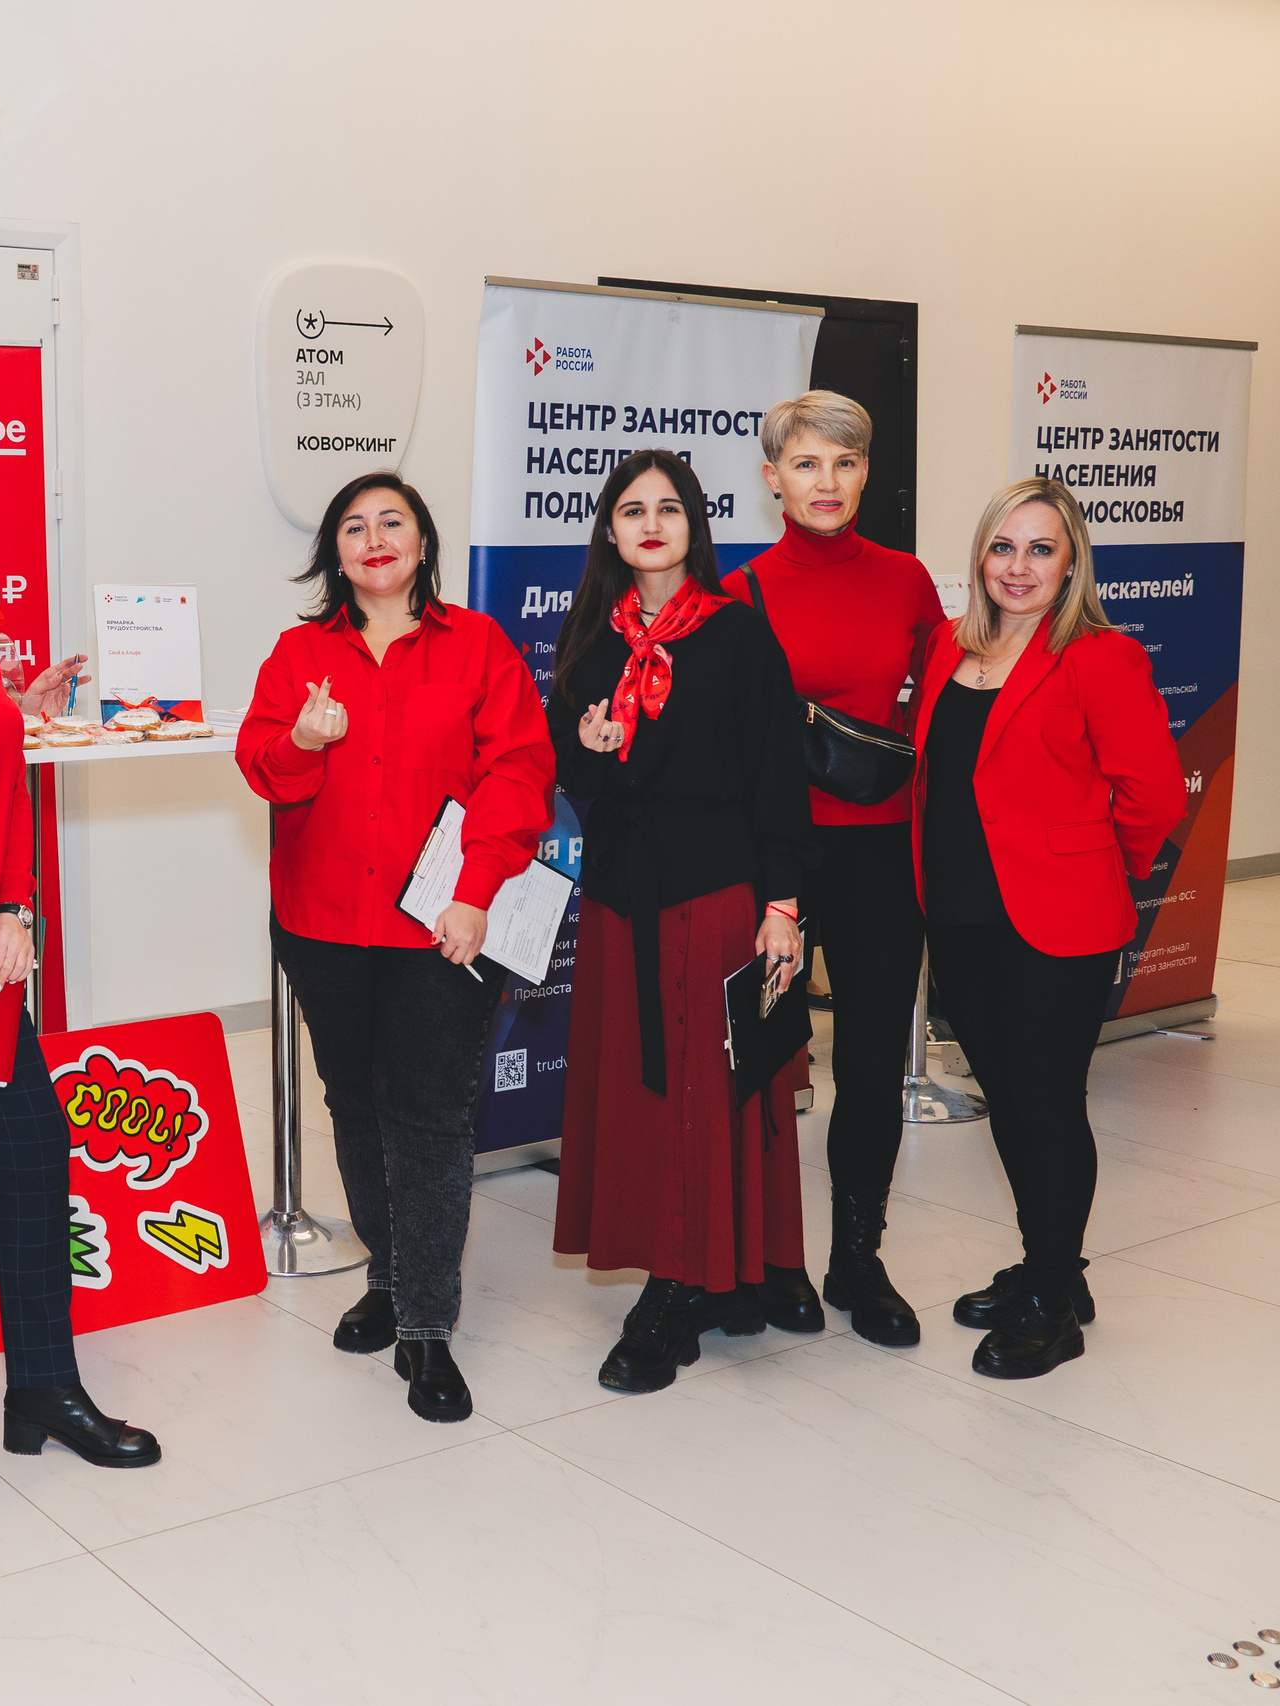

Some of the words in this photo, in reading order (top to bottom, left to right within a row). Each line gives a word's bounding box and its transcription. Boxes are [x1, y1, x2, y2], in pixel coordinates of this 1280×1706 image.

[296, 348, 344, 365] АТОМ
[556, 346, 592, 359] РАБОТА
[555, 359, 594, 372] РОССИИ
[296, 370, 325, 385] ЗАЛ
[1060, 379, 1087, 389] РАБОТА
[296, 391, 311, 410] (3
[314, 393, 362, 411] ЭТАЖ)
[1060, 390, 1088, 400] РОССИИ
[528, 401, 617, 434] ЦЕНТР
[623, 405, 767, 437] ЗАНЯТОСТ
[297, 436, 397, 453] КОВОРКИНГ
[1036, 425, 1104, 453] ЦЕНТР
[1108, 427, 1220, 453] ЗАНЯТОСТИ
[525, 491, 735, 524] ПОДМЬЯ
[1078, 500, 1185, 523] МОСКОВЬЯ
[1096, 572, 1194, 600] искателей
[521, 586, 573, 618] Для
[535, 641, 557, 654] Пом
[1158, 682, 1198, 696] ательской
[1135, 894, 1178, 911] программе
[1178, 889, 1197, 901] ФСС
[1126, 964, 1157, 979] Центра
[1157, 954, 1197, 971] занятости
[514, 983, 572, 1000] Предоста
[65, 1081, 185, 1152] COOL!
